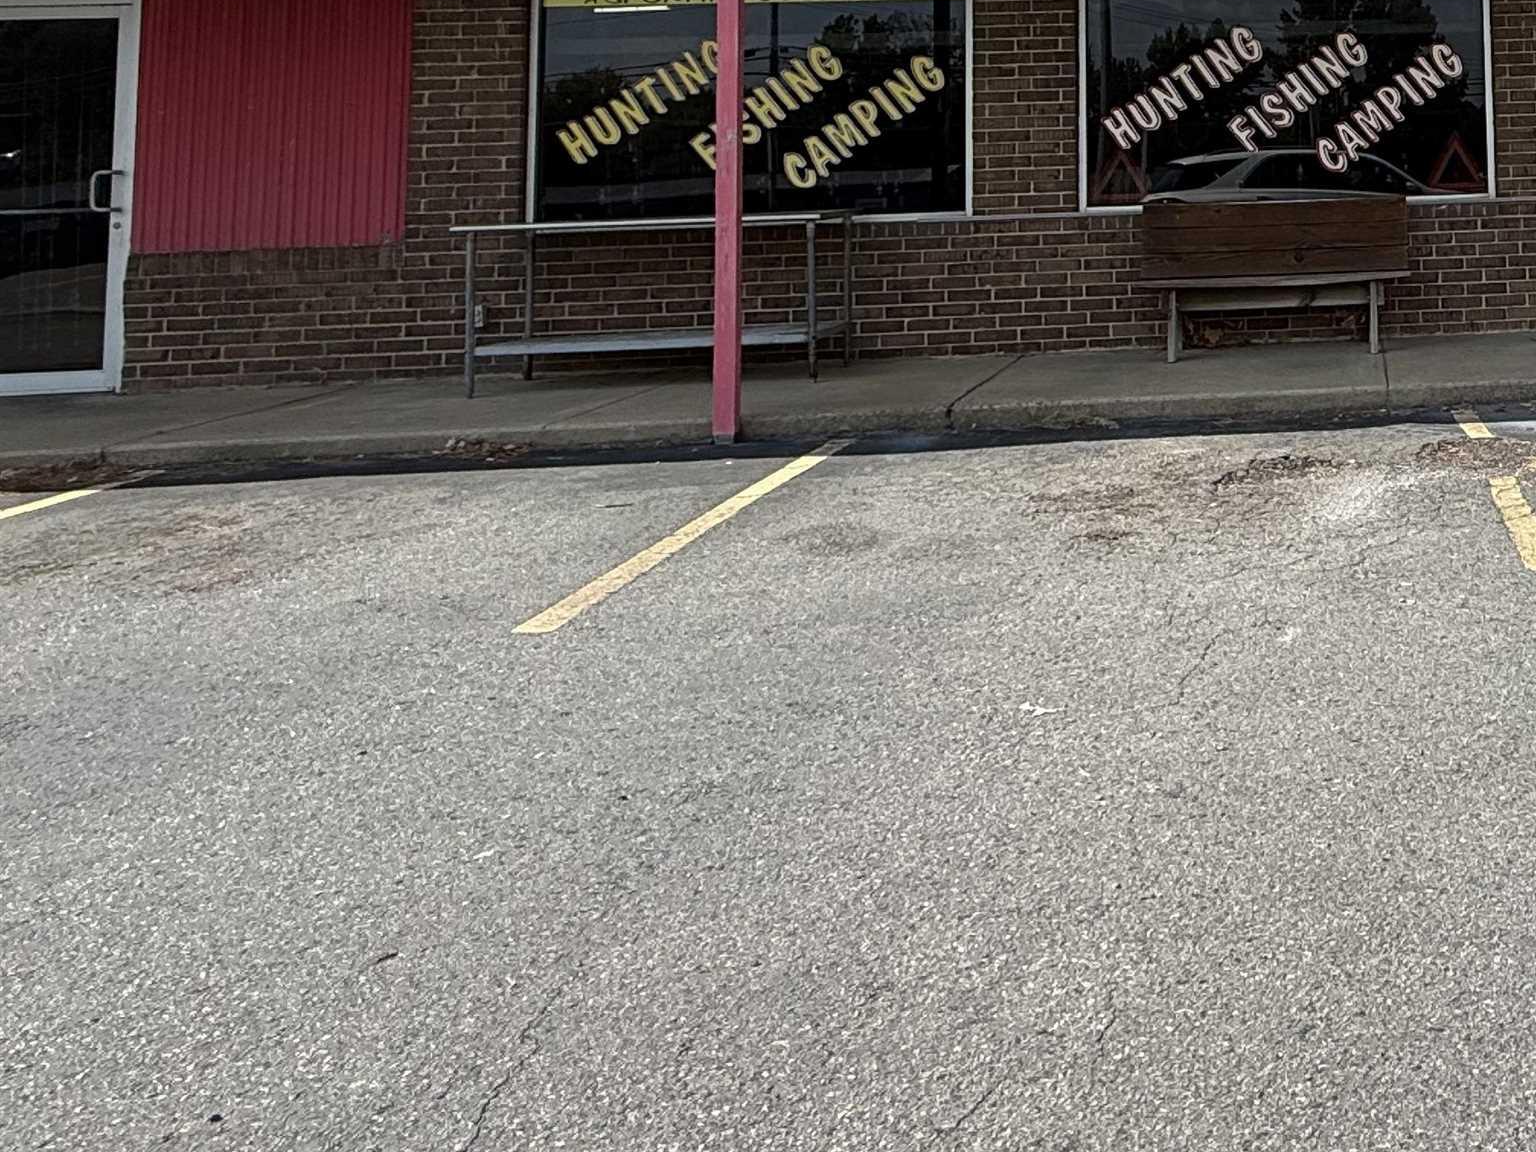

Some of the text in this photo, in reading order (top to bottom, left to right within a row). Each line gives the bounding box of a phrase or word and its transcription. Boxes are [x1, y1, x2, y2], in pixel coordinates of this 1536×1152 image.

[688, 44, 844, 171] FSHING
[782, 54, 946, 190] CAMPING
[1101, 24, 1264, 150] HUNTING
[1225, 30, 1369, 154] FISHING
[1315, 42, 1464, 174] CAMPING
